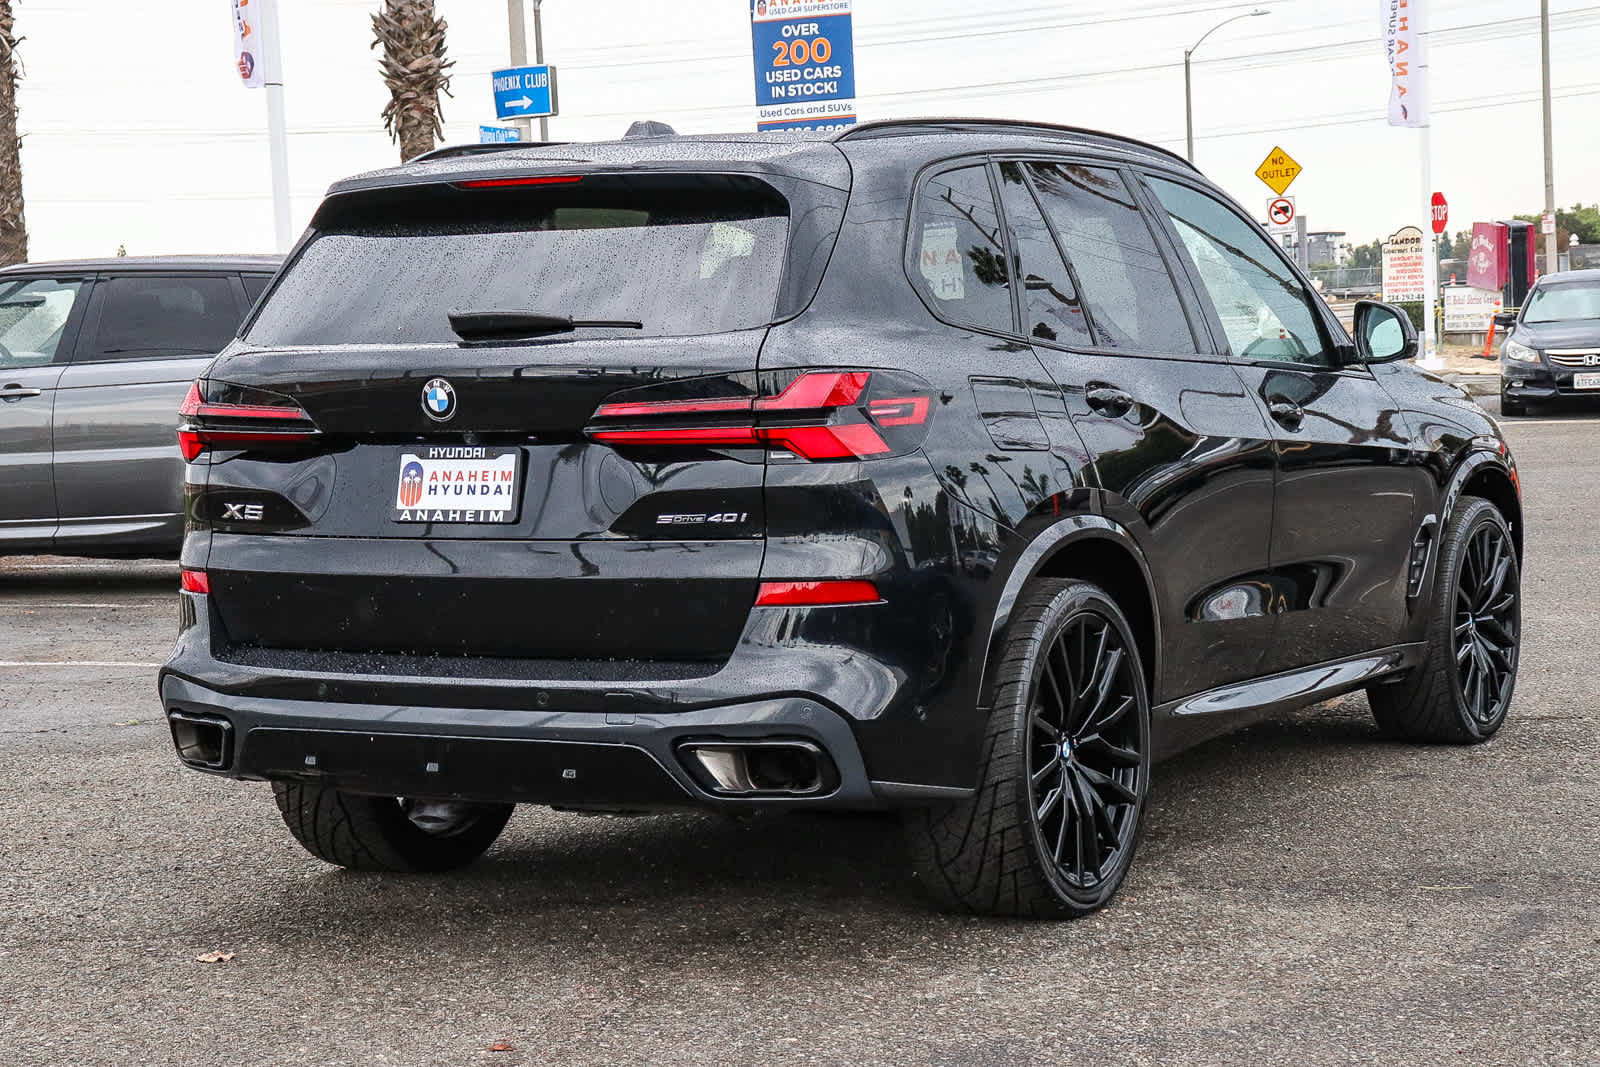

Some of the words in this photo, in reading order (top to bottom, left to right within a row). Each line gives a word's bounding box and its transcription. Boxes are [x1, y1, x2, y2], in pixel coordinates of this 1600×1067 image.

[769, 8, 787, 16] USED
[788, 6, 802, 14] CAR
[803, 2, 849, 13] SUPERSTORE
[782, 23, 820, 37] OVER
[772, 37, 832, 67] 200
[765, 69, 802, 84] USED
[803, 65, 842, 80] CARS
[494, 75, 522, 92] PHOENIX
[525, 73, 548, 88] CLUB
[771, 86, 786, 98] IN
[787, 81, 838, 97] STOCK!
[760, 109, 783, 119] Used
[783, 106, 805, 116] Cars
[806, 104, 826, 114] and
[827, 102, 853, 113] SUVs
[1271, 156, 1285, 165] NO
[1262, 167, 1296, 180] OUTLET
[1432, 204, 1449, 221] STOP
[424, 380, 452, 394] BMW
[429, 447, 486, 459] HYUNDAI
[429, 470, 513, 482] ANAHEIM
[428, 484, 512, 496] HYUNDAI
[221, 503, 264, 520] X5
[399, 509, 504, 522] ANAHEIM
